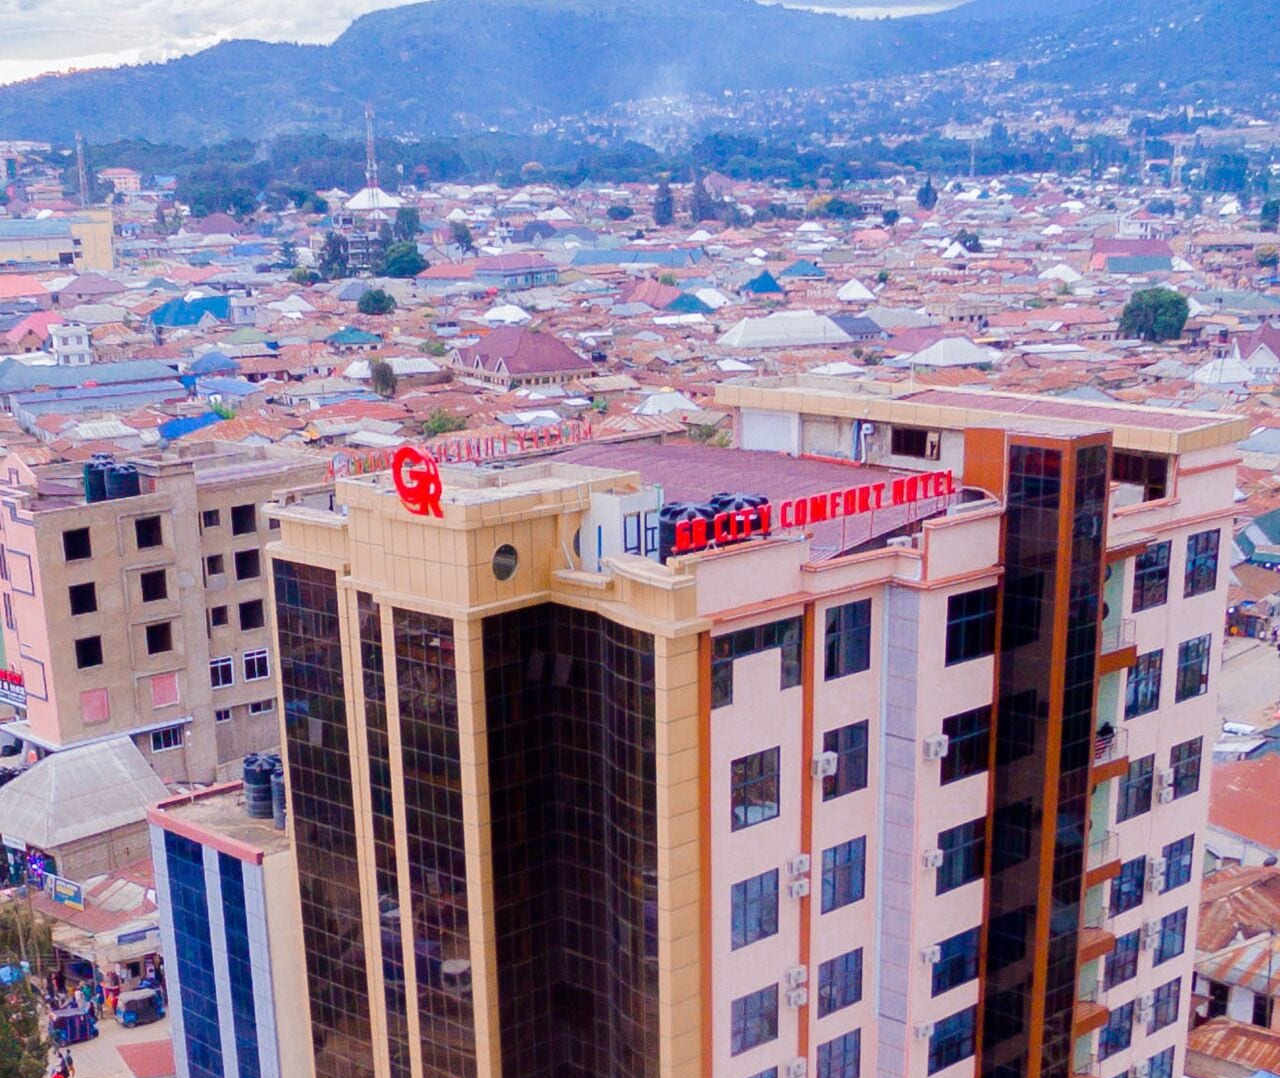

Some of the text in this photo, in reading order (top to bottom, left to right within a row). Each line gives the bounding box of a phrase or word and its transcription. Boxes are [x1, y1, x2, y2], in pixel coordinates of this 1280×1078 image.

[674, 469, 956, 551] GR CITY COMFORT HOTEL
